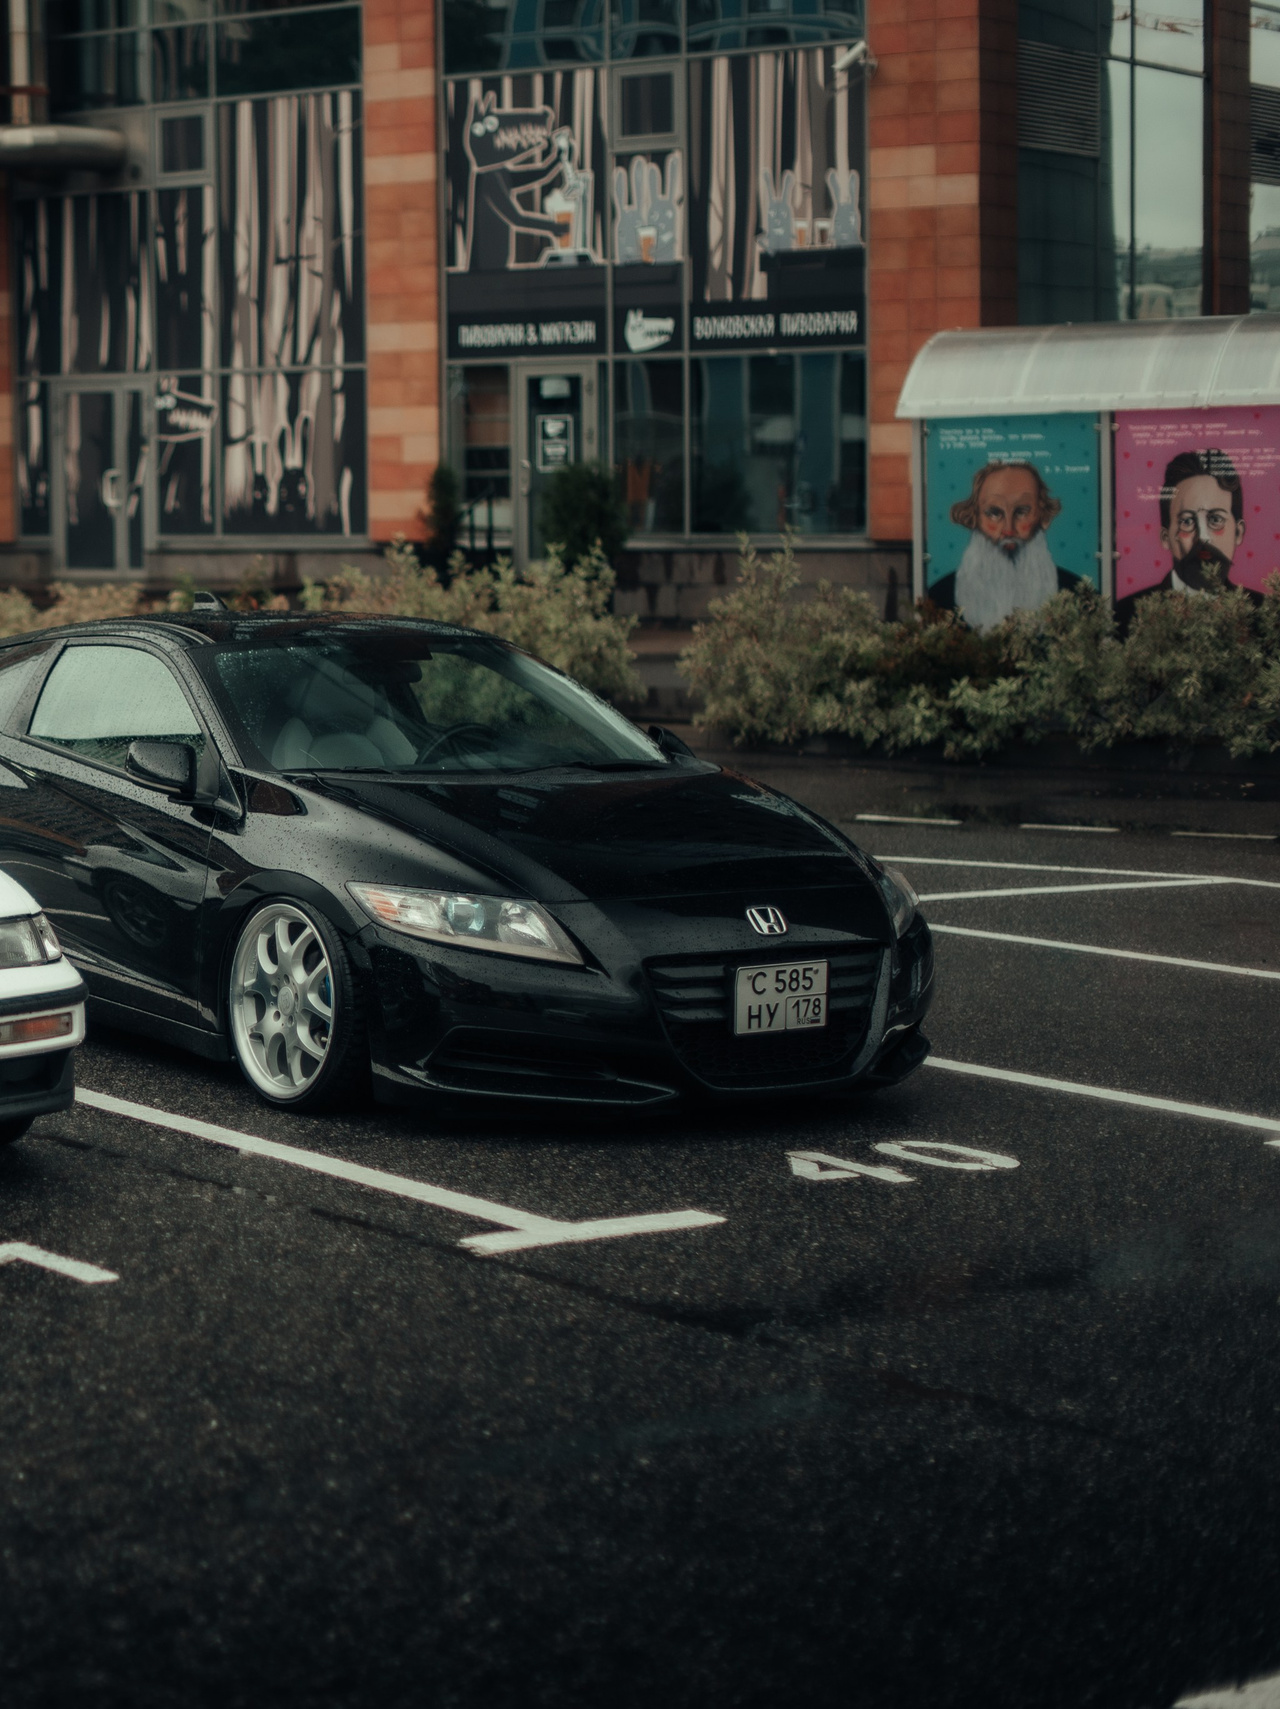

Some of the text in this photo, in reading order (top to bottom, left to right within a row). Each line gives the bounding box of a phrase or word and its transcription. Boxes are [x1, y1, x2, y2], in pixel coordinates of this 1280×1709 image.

[694, 310, 858, 340] ВОЛКОВСКАЯ ПИВОВАРНЯ
[774, 967, 814, 993] 585
[792, 997, 822, 1018] 178
[797, 1017, 811, 1025] RUS
[785, 1140, 1021, 1183] 40
